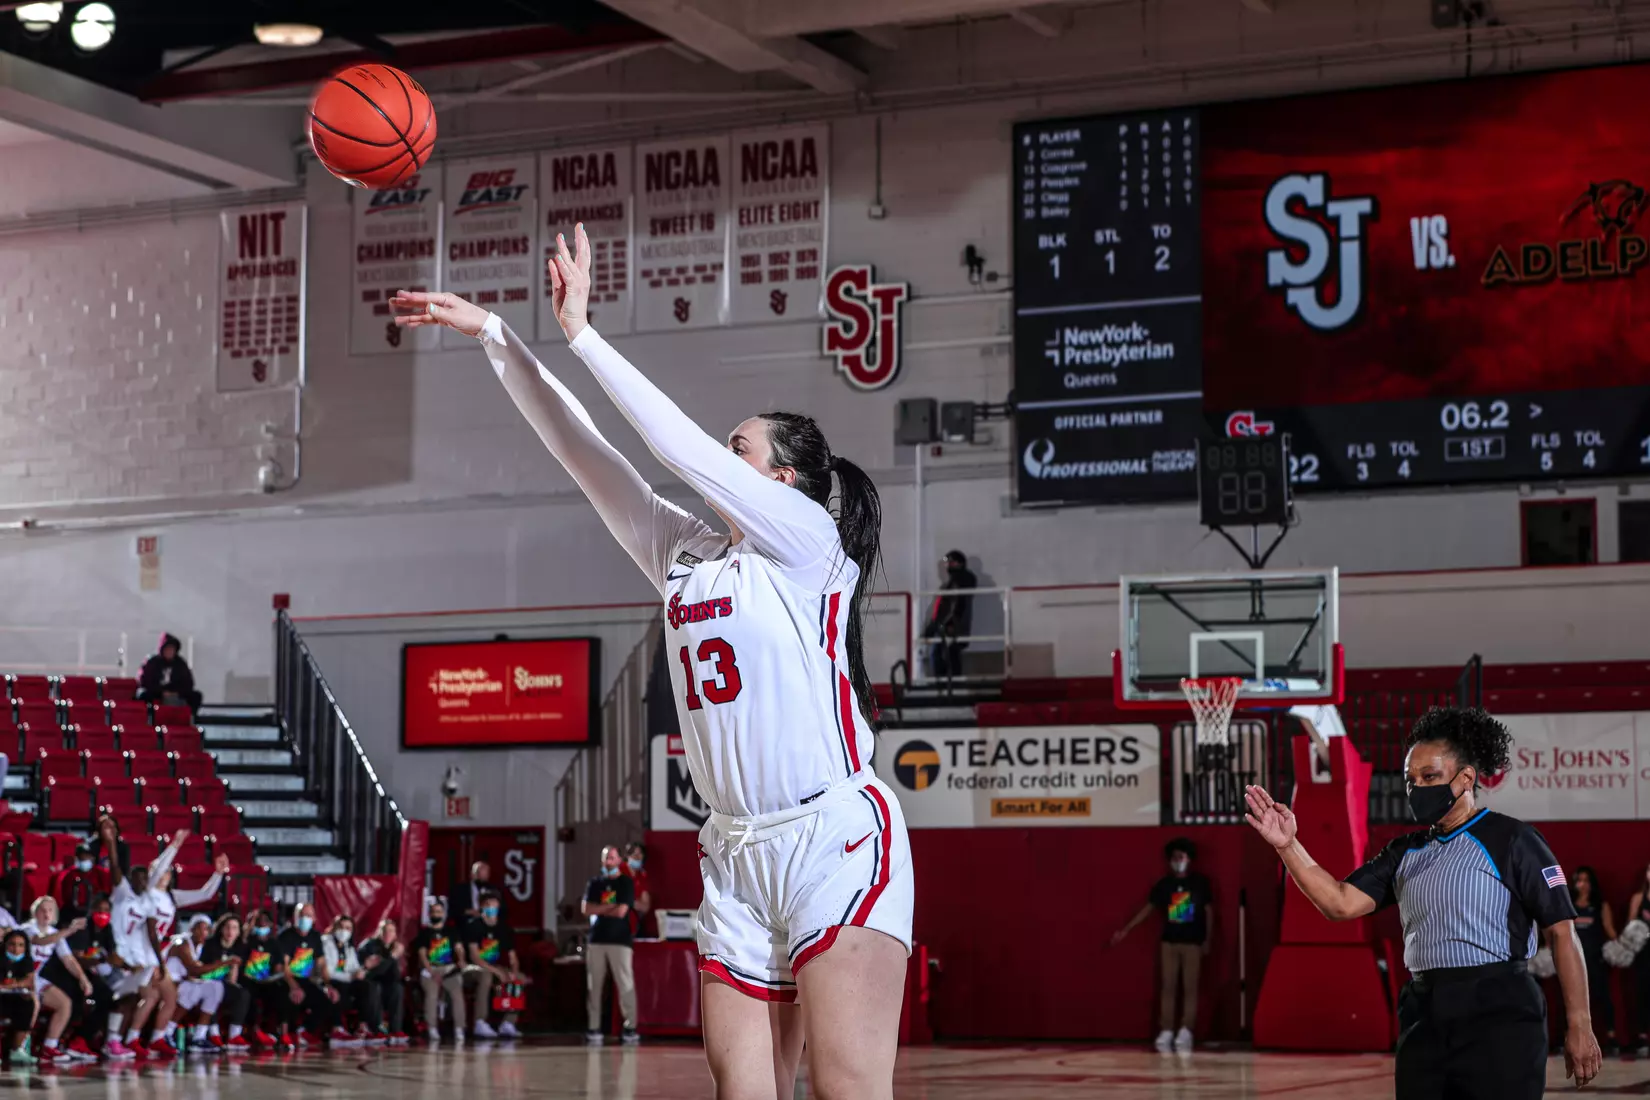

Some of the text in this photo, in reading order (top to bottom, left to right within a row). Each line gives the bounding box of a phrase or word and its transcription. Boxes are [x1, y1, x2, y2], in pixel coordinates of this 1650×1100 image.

[1039, 129, 1081, 144] PLAYER
[1118, 124, 1129, 136] P
[1139, 121, 1149, 134] R
[1161, 119, 1171, 132] A
[645, 147, 721, 192] NCAA
[742, 137, 818, 184] NCAA
[466, 169, 517, 189] BIG
[552, 153, 617, 194] NCAA
[459, 185, 529, 206] EAST
[547, 203, 624, 227] APPEARANCES
[650, 212, 715, 238] SWEET 16
[738, 200, 820, 228] ELITE EIGHT
[238, 212, 286, 259] NIT
[1038, 225, 1172, 249] BLK STL TO
[1410, 215, 1455, 271] VS.
[356, 238, 435, 264] CHAMPIONS
[449, 236, 530, 262] CHAMPIONS
[1049, 246, 1171, 279] 1 1 2
[1064, 341, 1175, 368] Presbyterian
[1064, 371, 1117, 389] Queens
[1054, 410, 1163, 430] OFFICIAL PARTNER
[1440, 401, 1509, 431] 06.2
[1347, 441, 1420, 459] FLS TOL
[1459, 440, 1493, 457] 1ST
[1531, 431, 1606, 449] FLS TOL
[1041, 459, 1149, 479] PROFESSIONAL
[1357, 460, 1412, 480] 3 4
[1540, 450, 1597, 471] 5 4
[679, 636, 743, 711] 13
[944, 736, 1141, 767] TEACHERS
[1517, 747, 1631, 774] ST. JOHN'S
[946, 769, 1140, 790] federal credit union
[1518, 773, 1629, 790] UNIVERSITY
[447, 796, 470, 817] EXIT
[996, 799, 1087, 815] Smart For All
